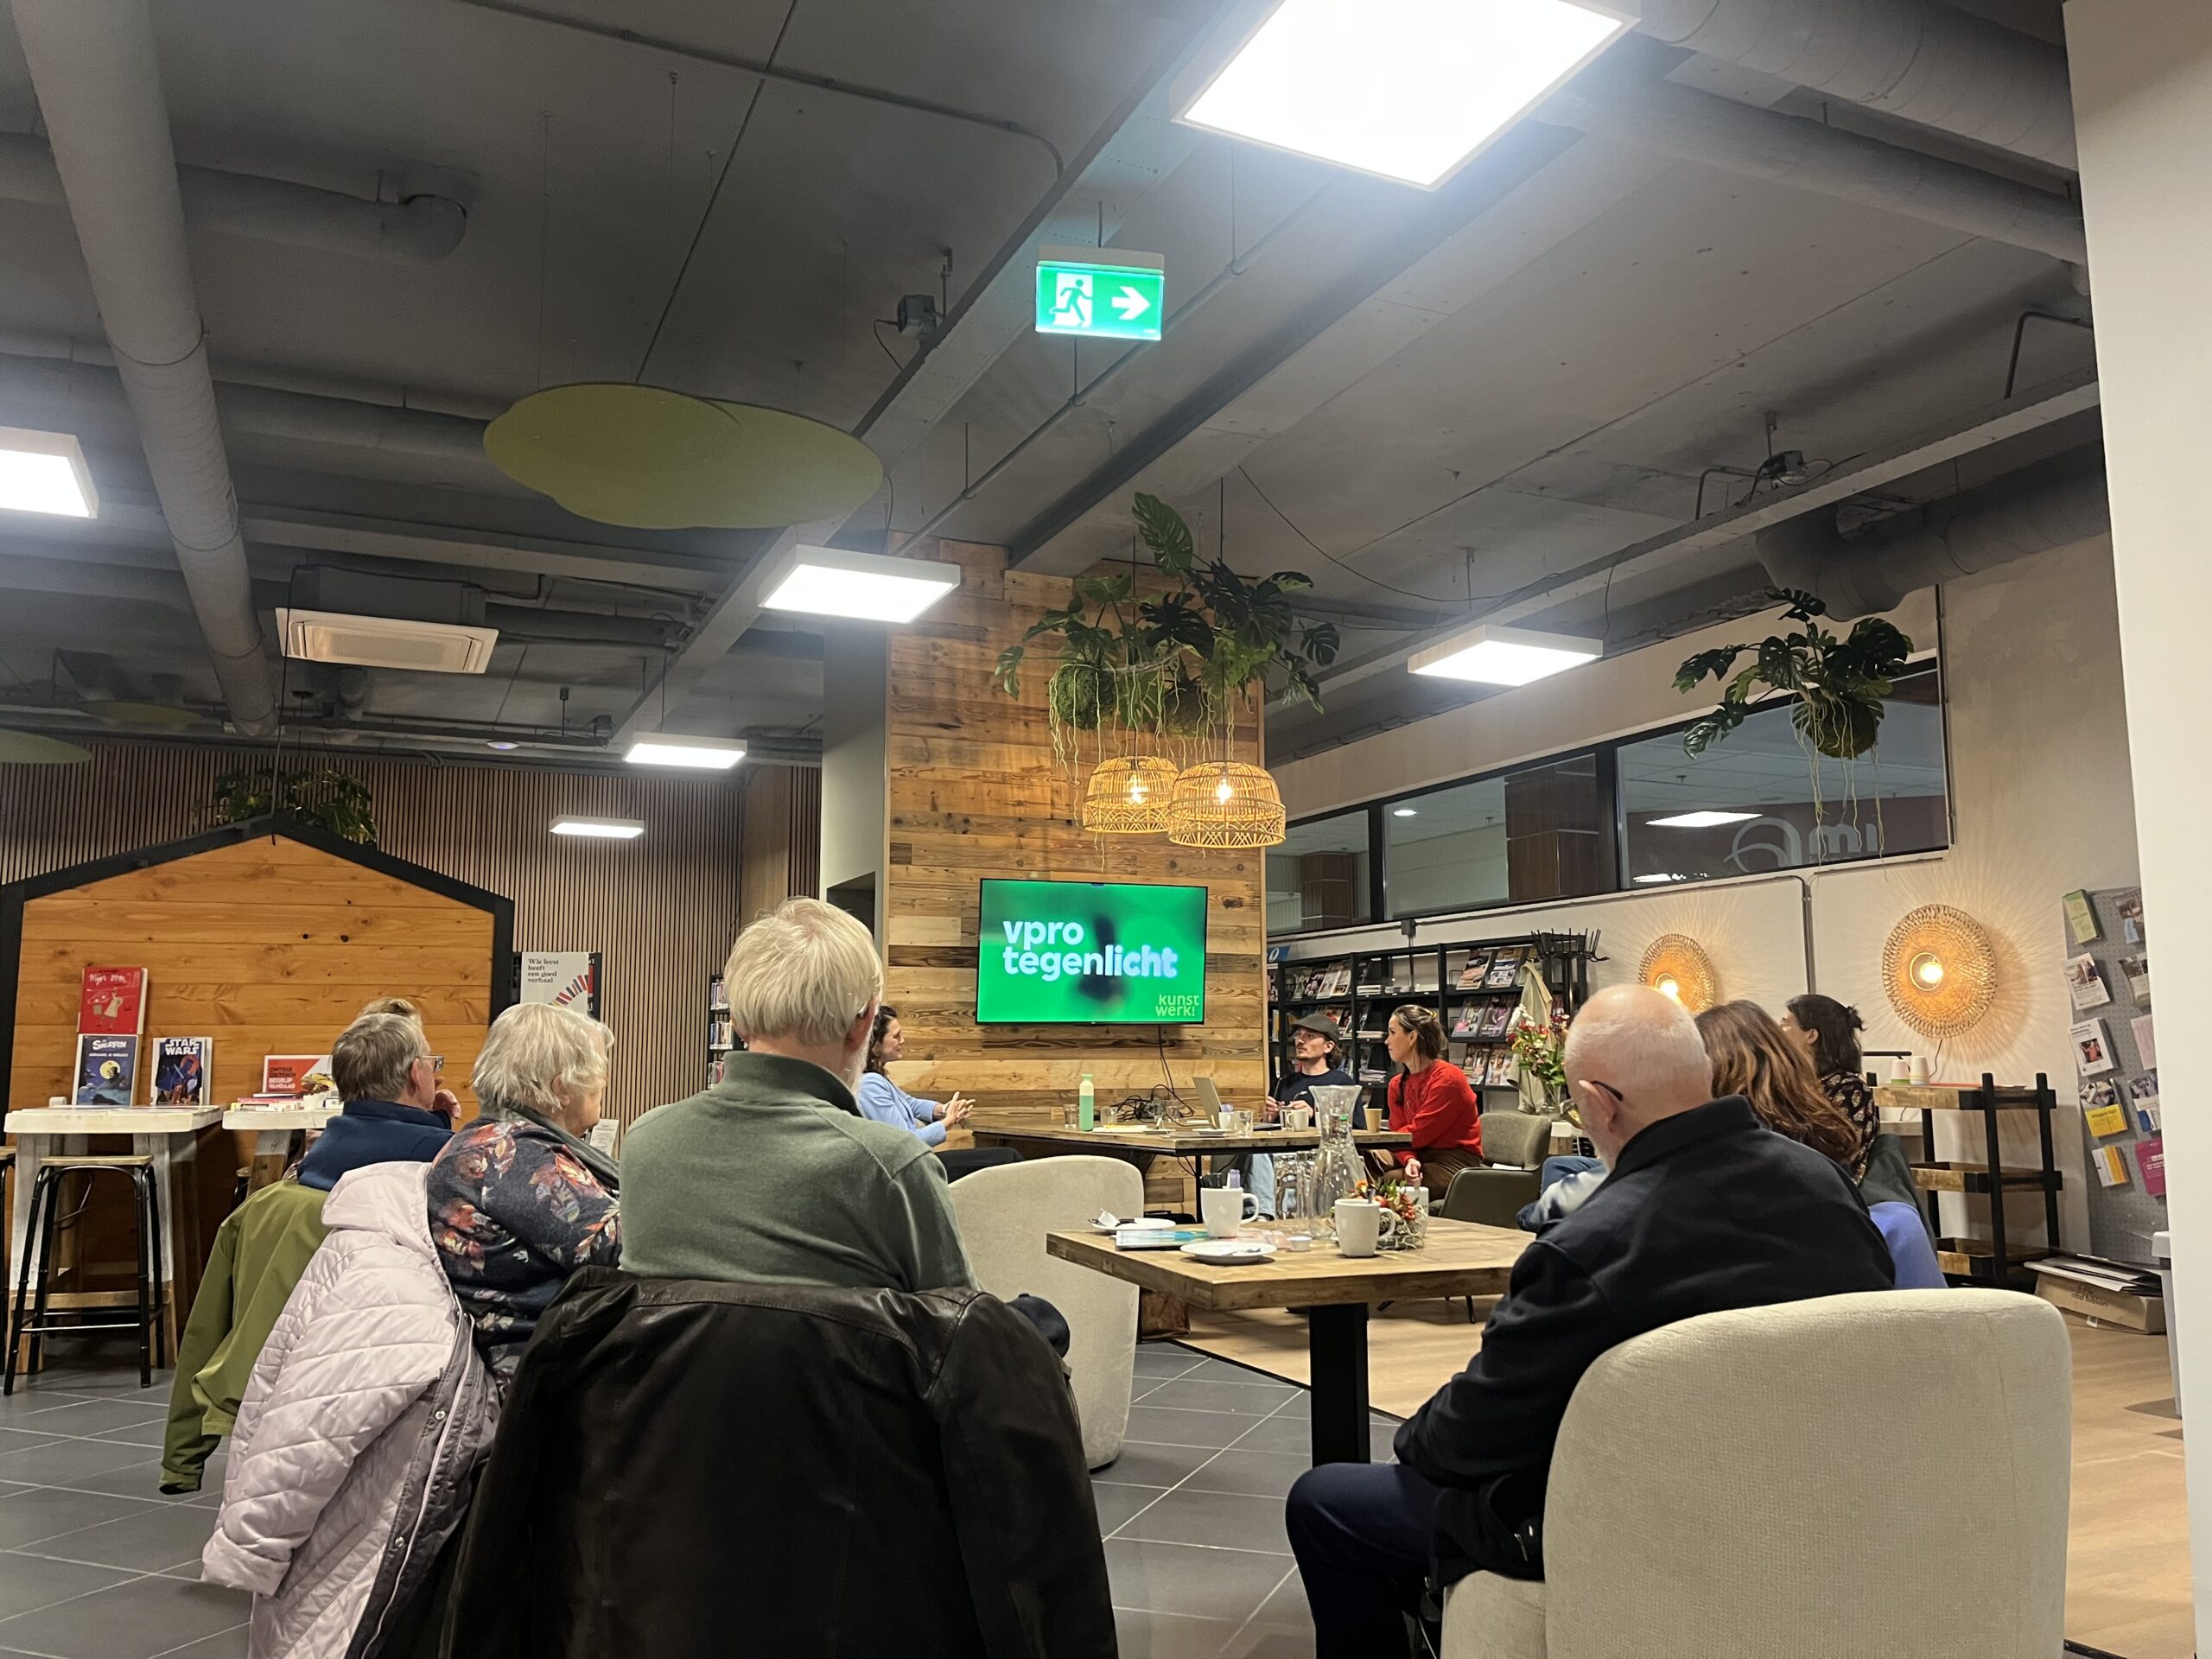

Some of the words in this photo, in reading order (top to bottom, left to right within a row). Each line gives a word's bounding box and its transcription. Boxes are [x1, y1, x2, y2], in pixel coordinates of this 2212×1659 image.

[1002, 921, 1084, 950] vpro
[1002, 944, 1179, 982] tegenlicht
[1159, 994, 1199, 1006] kunst
[1155, 1006, 1195, 1016] werk!
[165, 1046, 200, 1055] WARS
